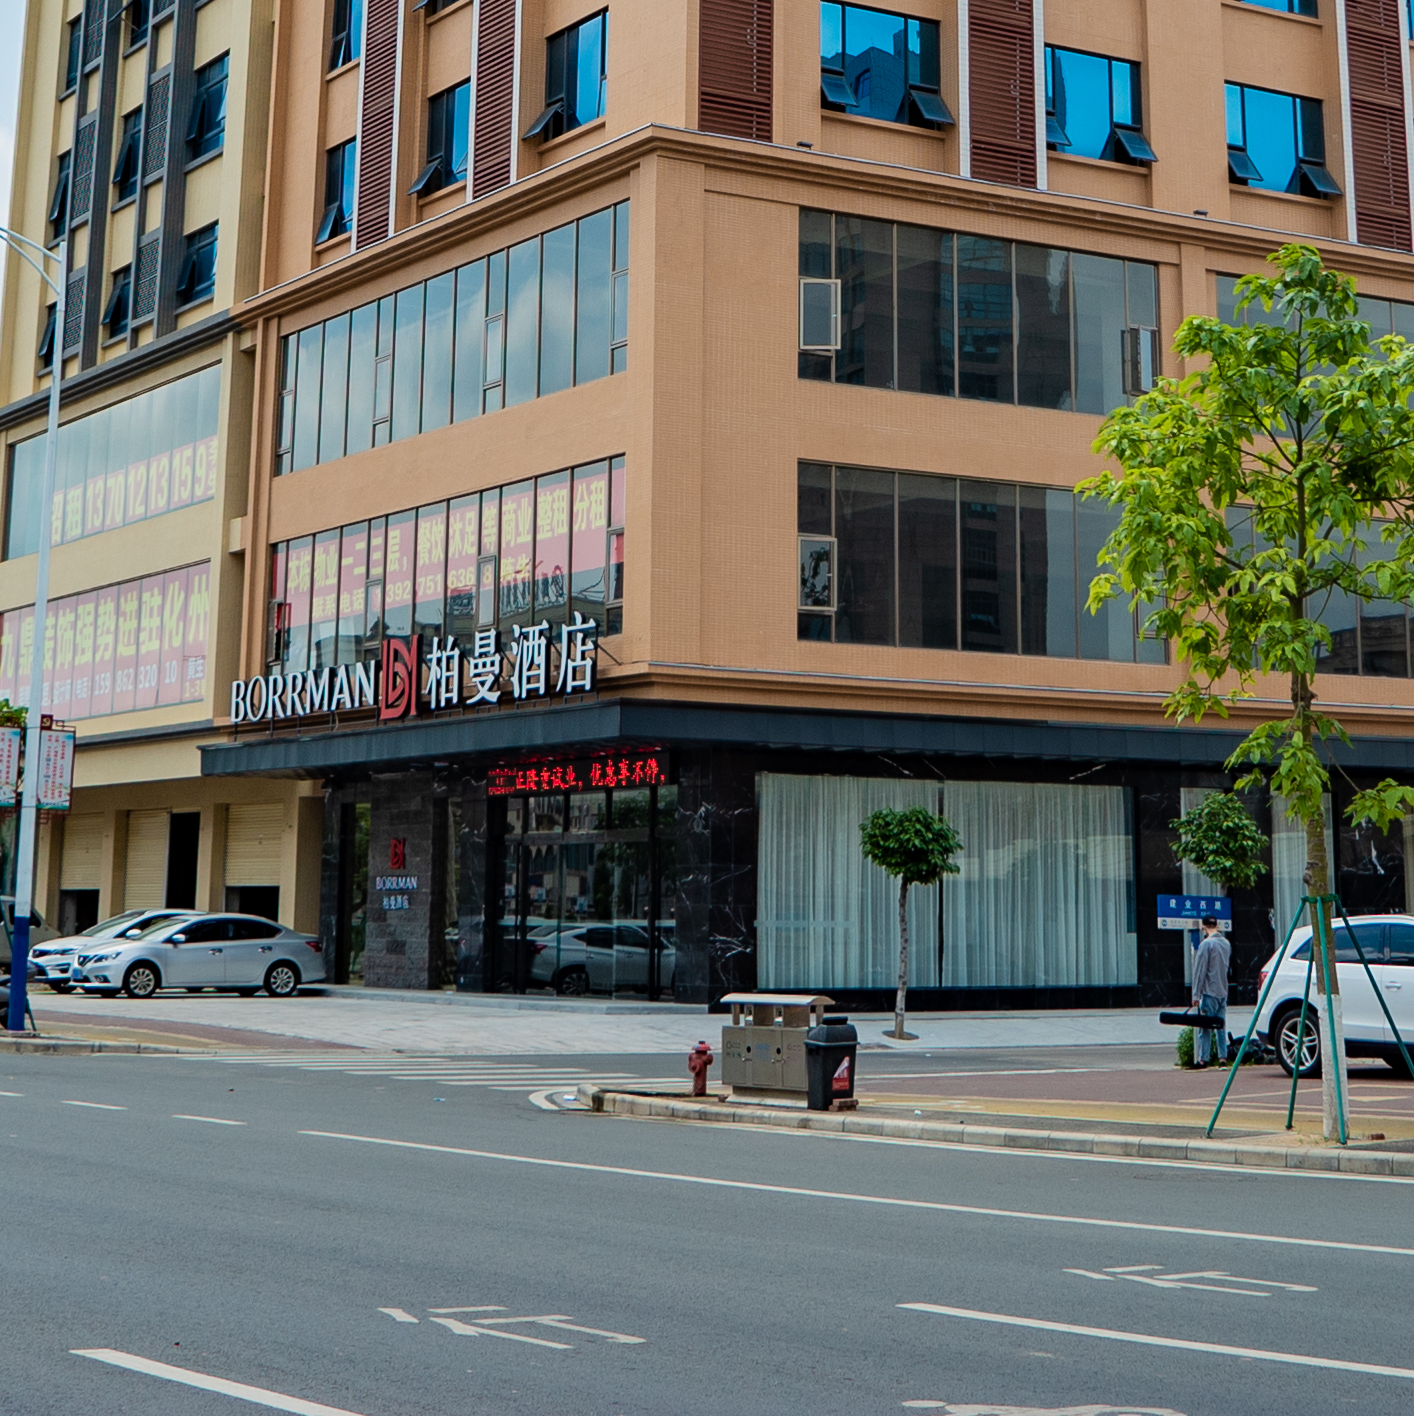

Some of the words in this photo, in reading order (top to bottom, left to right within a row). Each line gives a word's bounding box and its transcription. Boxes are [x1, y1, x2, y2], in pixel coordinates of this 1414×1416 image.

[313, 586, 364, 618] 联系电话
[425, 611, 597, 710] 柏曼酒店
[230, 659, 377, 723] BORRMAN
[376, 875, 417, 890] BORRMAN
